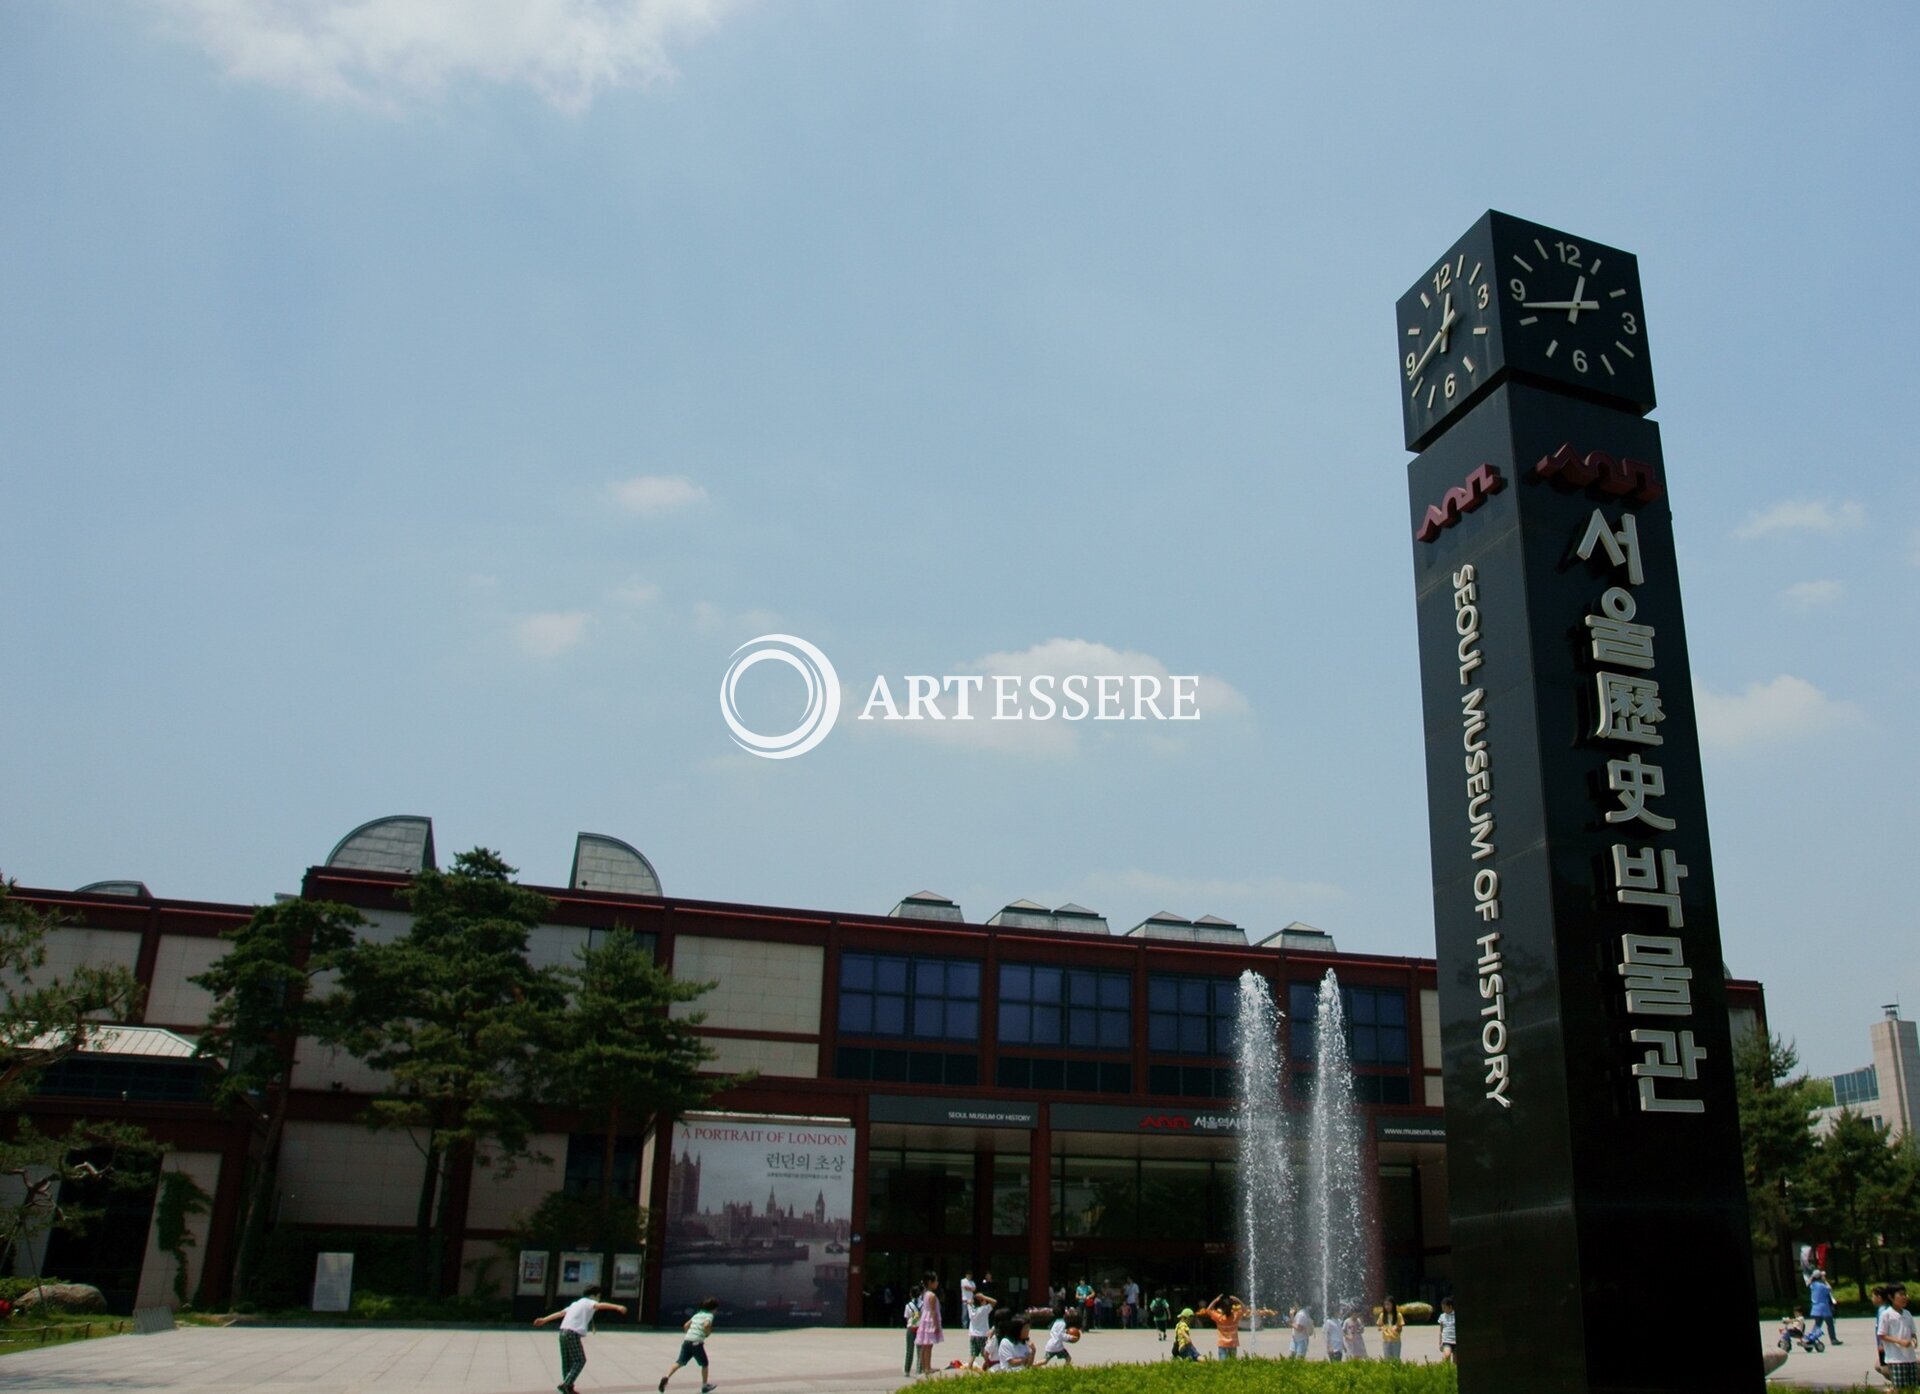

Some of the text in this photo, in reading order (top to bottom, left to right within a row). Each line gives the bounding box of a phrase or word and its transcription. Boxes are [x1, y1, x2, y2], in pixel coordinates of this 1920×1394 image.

[1555, 241, 1582, 268] 12
[1433, 262, 1451, 295] 12
[1509, 278, 1526, 301] 9
[1476, 283, 1489, 310] 3
[1621, 311, 1638, 335] 3
[1405, 352, 1417, 377] 9
[1572, 349, 1588, 373] 6
[1443, 372, 1456, 398] 6
[1453, 564, 1512, 1108] SEOUL MUSEUM OF HISTORY
[948, 1111, 1031, 1122] SEOUL MUSEUM OF HISTORY
[682, 1128, 848, 1146] A PORTRAIT OF LONDON
[766, 1151, 846, 1173] 런던의 초상
